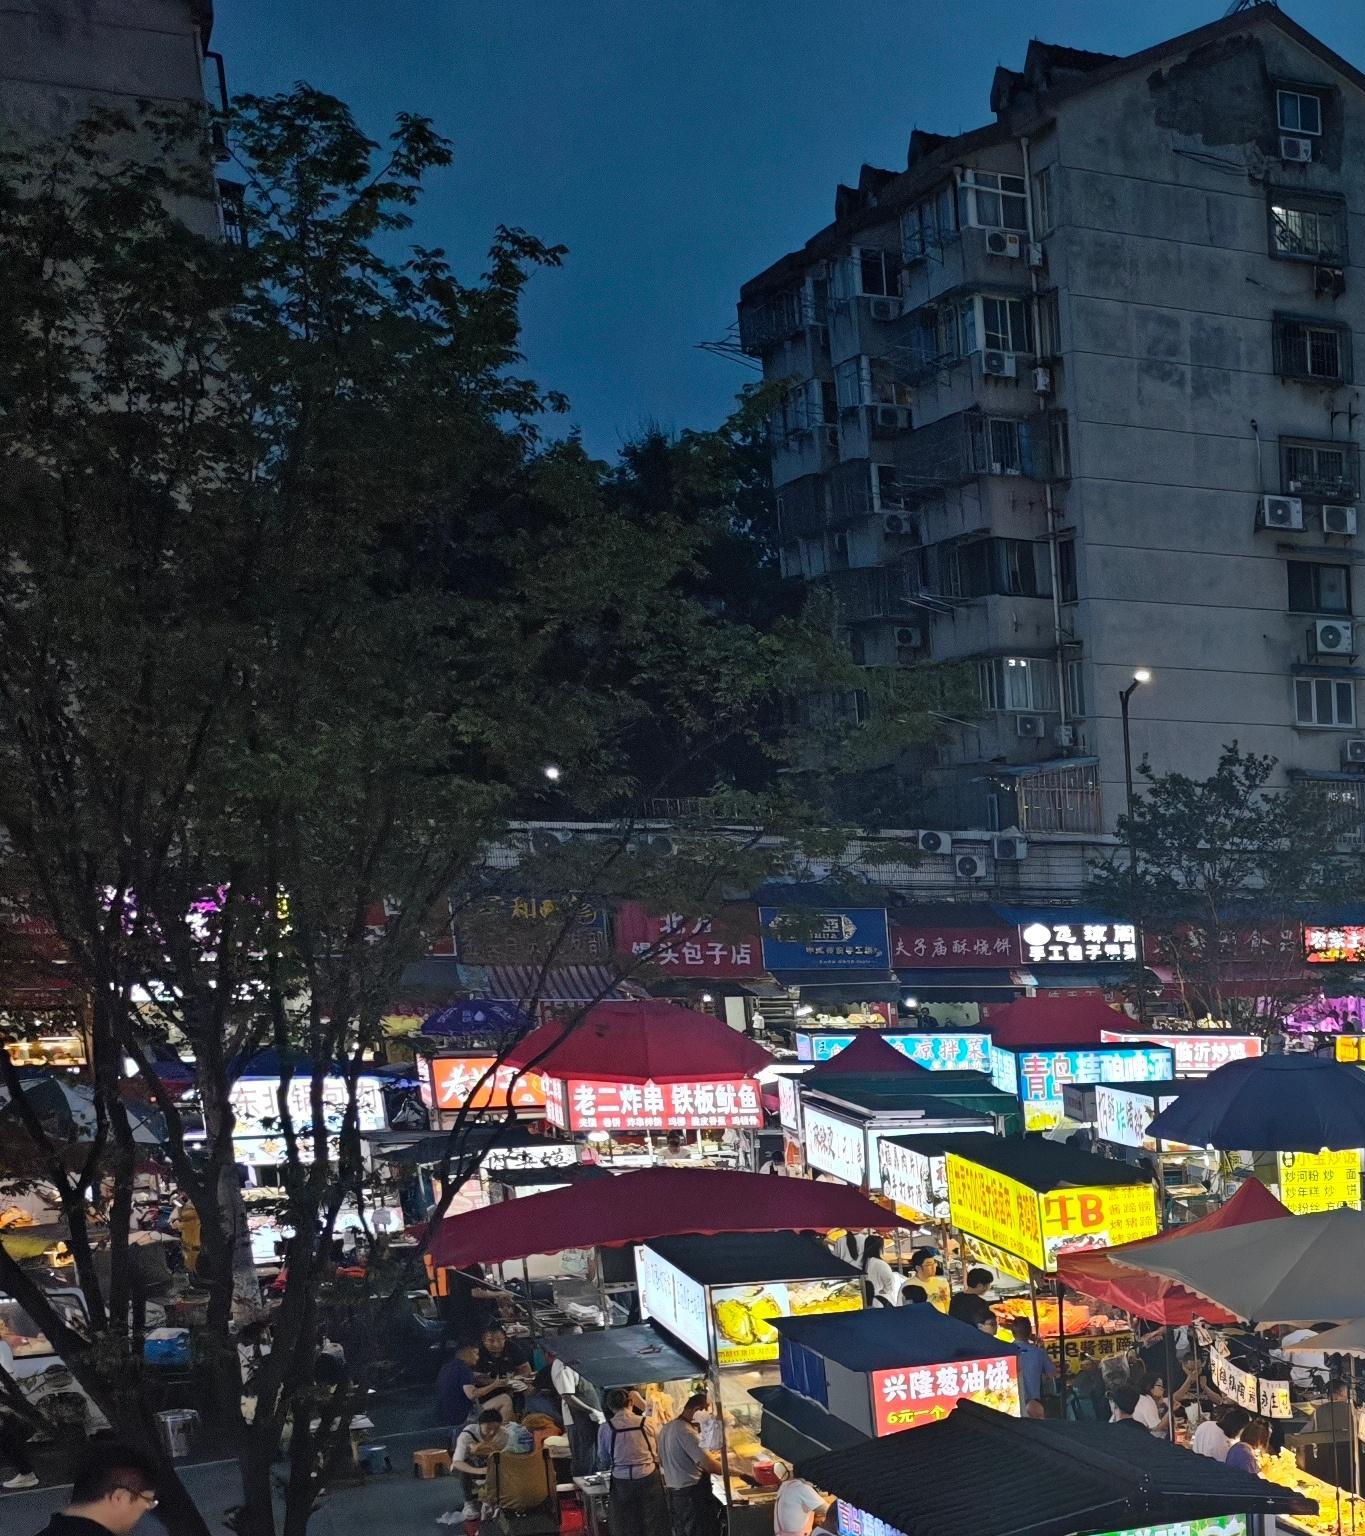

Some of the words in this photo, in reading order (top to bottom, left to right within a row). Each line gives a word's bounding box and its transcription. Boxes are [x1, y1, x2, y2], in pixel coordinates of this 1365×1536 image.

[574, 1084, 664, 1116] 老二炸串
[671, 1084, 759, 1115] 铁板鱿鱼
[1285, 1171, 1319, 1182] 炒河粉
[883, 1362, 1011, 1403] 兴隆葱油饼
[887, 1404, 945, 1425] 6元一个
